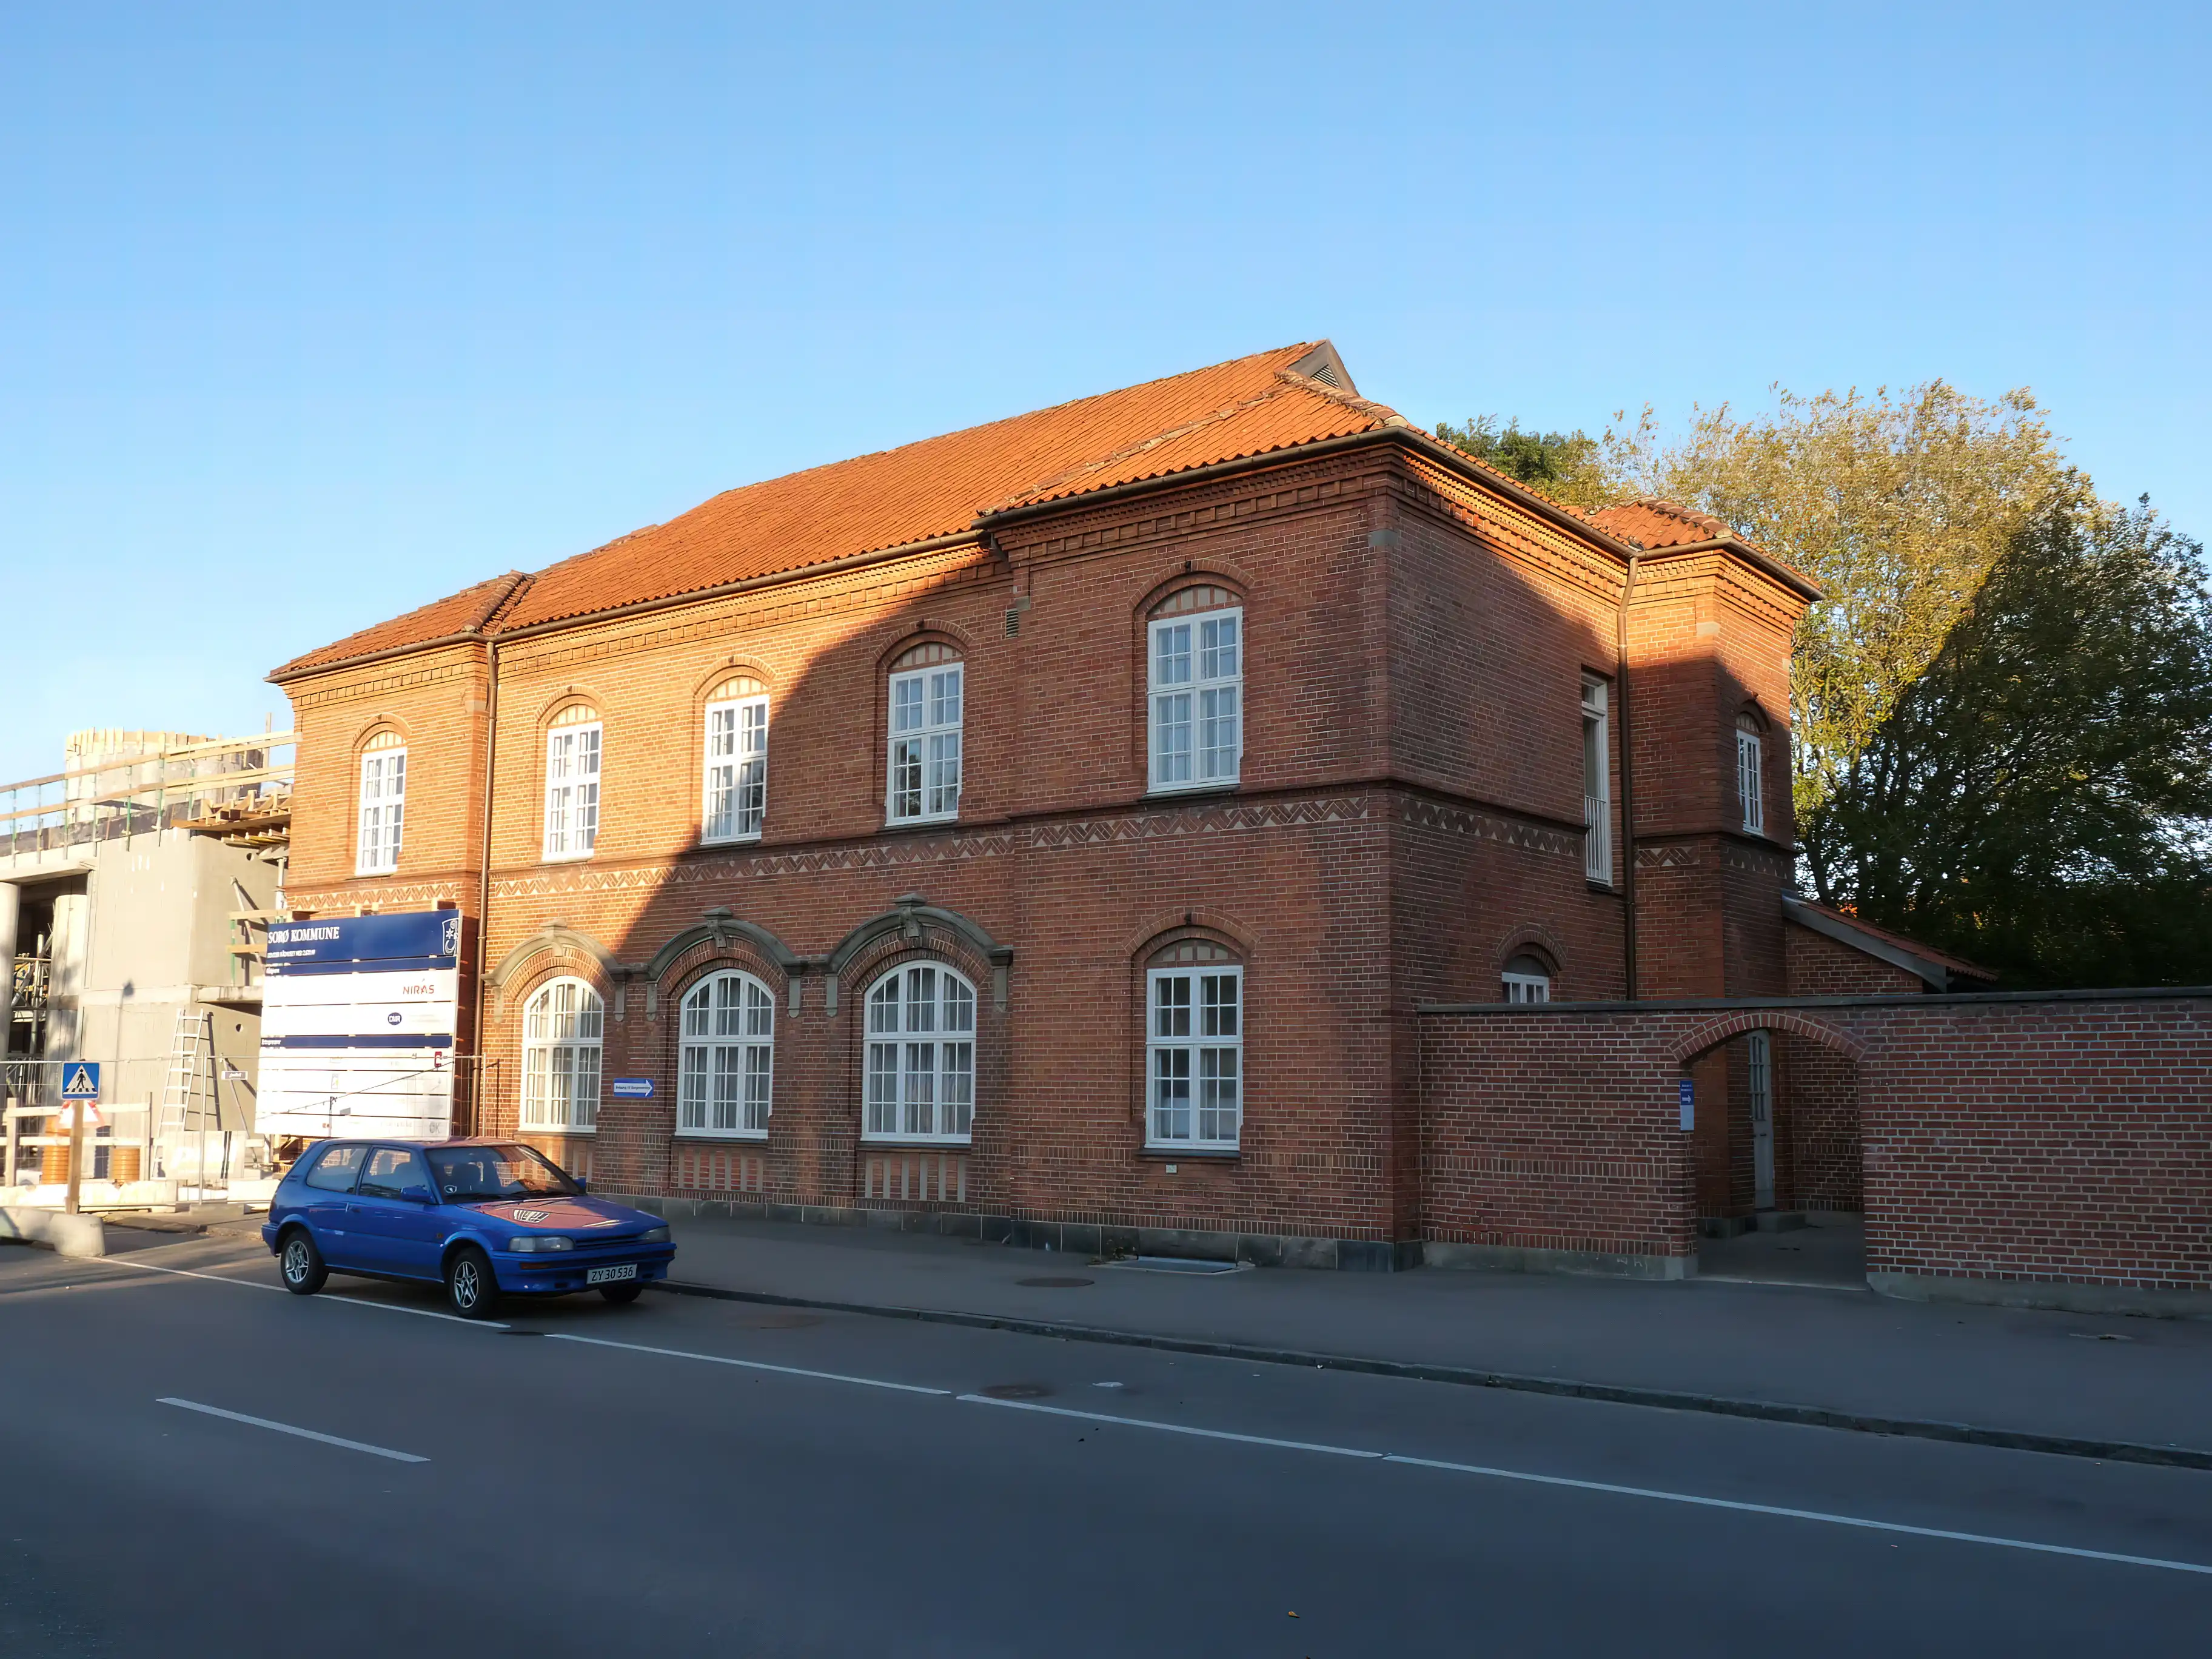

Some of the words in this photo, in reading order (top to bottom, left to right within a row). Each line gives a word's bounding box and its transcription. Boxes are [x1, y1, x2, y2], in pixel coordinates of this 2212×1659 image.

[268, 929, 289, 943] SORØ
[290, 927, 340, 942] KOMMUNE
[403, 985, 434, 994] NIRAS
[591, 1270, 603, 1281] ZY
[605, 1269, 615, 1279] 30
[617, 1267, 633, 1278] 536
